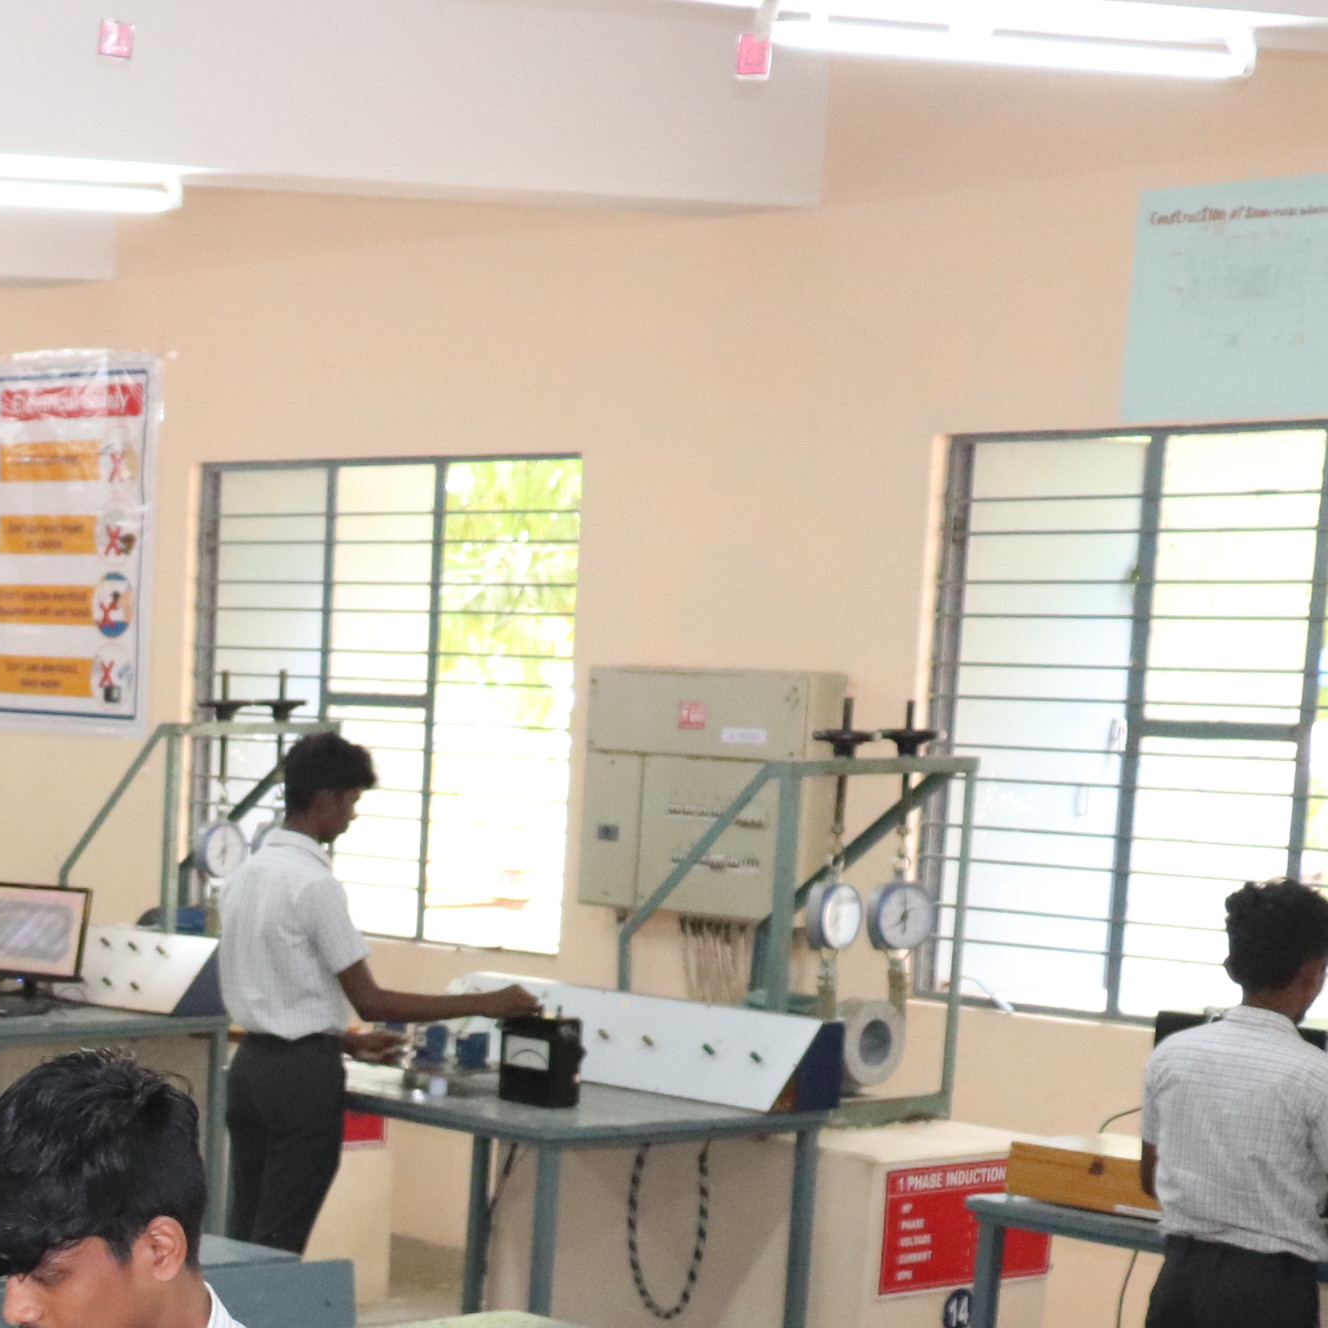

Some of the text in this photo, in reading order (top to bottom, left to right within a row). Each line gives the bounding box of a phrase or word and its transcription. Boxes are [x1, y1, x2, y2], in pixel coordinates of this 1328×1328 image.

[899, 1166, 1007, 1192] 1 PHASE INDUCTION
[948, 1296, 970, 1327] 14
